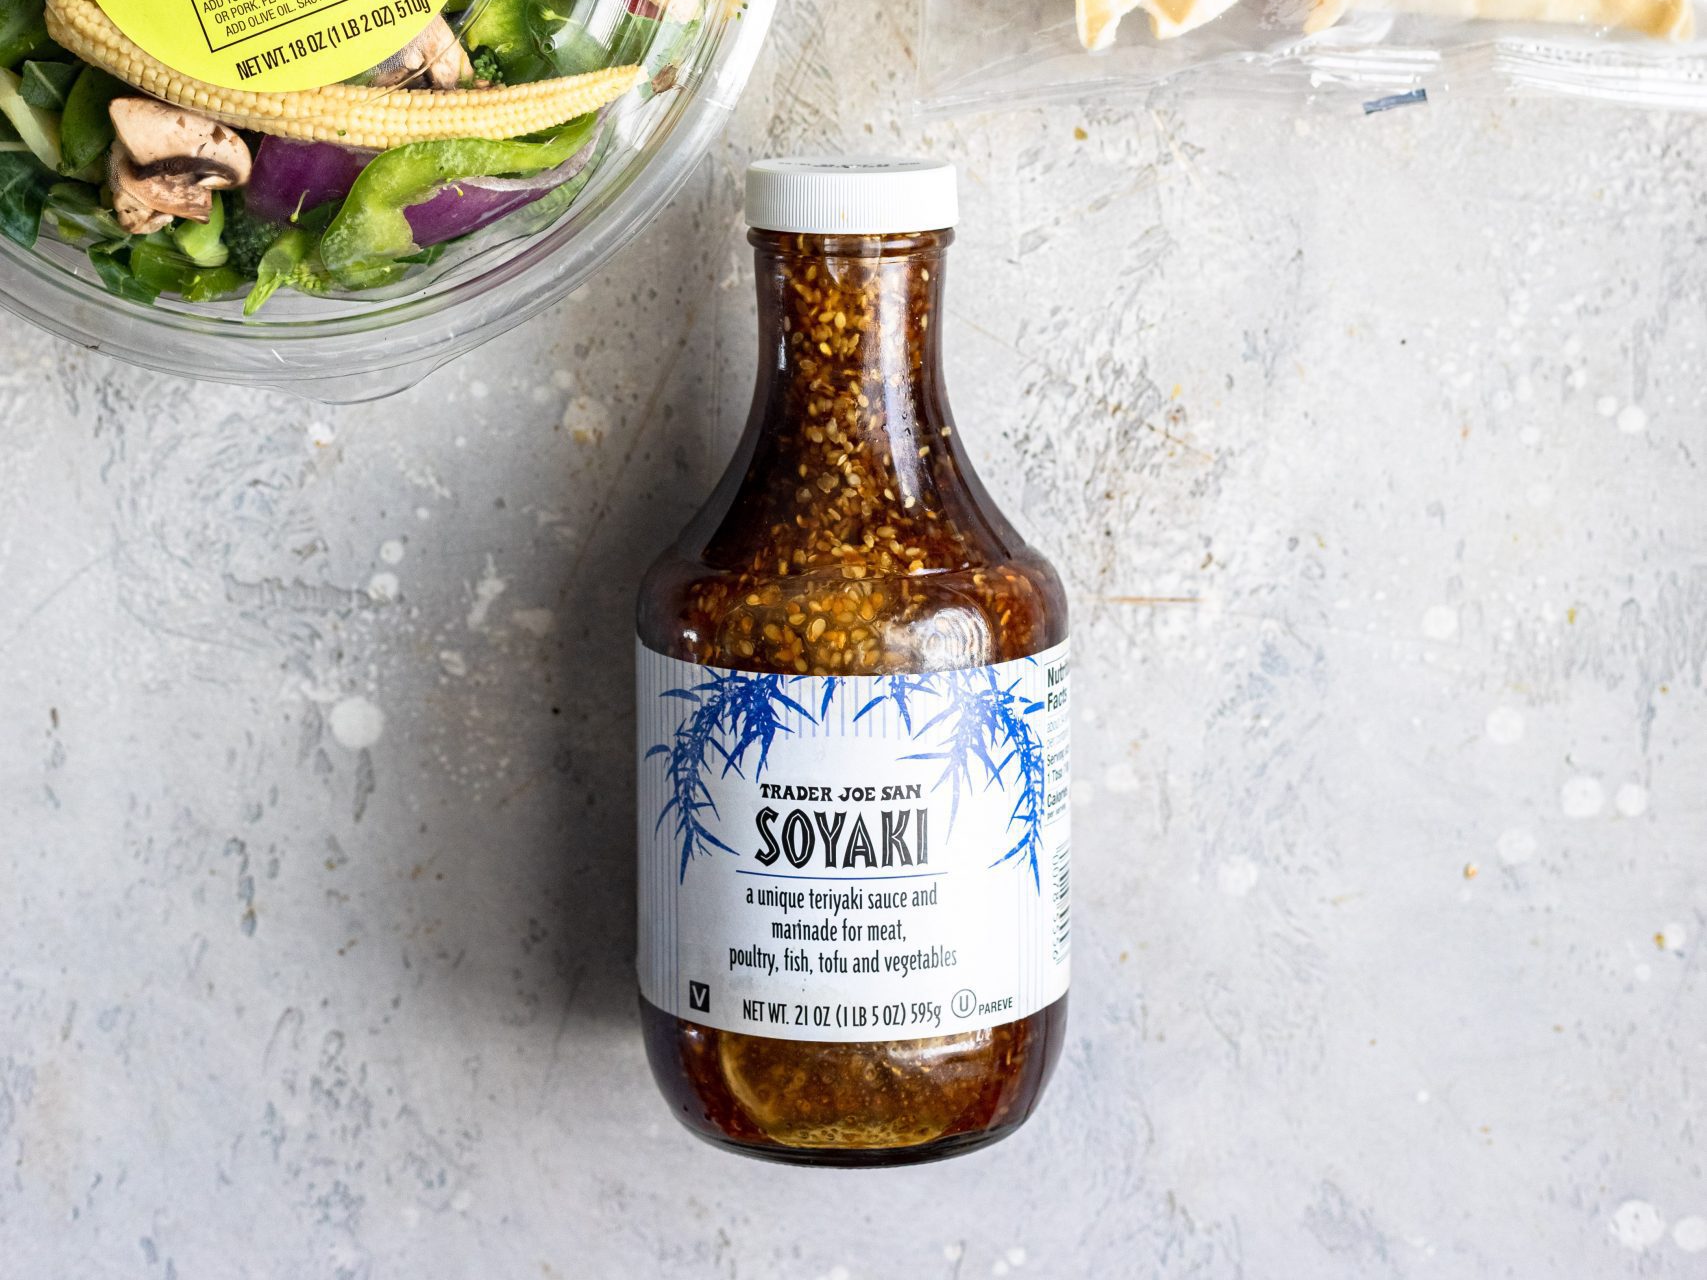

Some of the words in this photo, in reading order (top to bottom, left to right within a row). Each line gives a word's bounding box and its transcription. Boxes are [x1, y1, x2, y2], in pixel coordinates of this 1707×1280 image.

[215, 11, 229, 25] OR
[230, 0, 261, 18] PORK.
[226, 20, 247, 37] ADD
[248, 10, 277, 28] OLIVE
[276, 3, 297, 17] OIL.
[235, 52, 262, 81] NET
[261, 45, 291, 70] WT.
[288, 39, 307, 60] 18
[306, 31, 328, 53] OZ
[327, 24, 341, 49] (1
[340, 17, 361, 40] LB
[359, 14, 373, 32] 2
[372, 5, 396, 26] OZ)
[759, 783, 834, 802] TRADER
[837, 786, 878, 802] JOE
[880, 783, 923, 800] SAN
[754, 806, 929, 870] SOYAKI
[746, 887, 754, 905] a
[758, 886, 805, 915] unique
[809, 886, 863, 917] teriyaki
[868, 890, 907, 909] sauce
[912, 882, 938, 907] and
[772, 918, 838, 942] marinade
[842, 918, 863, 942] for
[867, 919, 906, 942] meat,
[729, 944, 779, 977] poultry,
[784, 947, 814, 975] fish,
[818, 950, 848, 974] tofu
[852, 950, 880, 973] and
[884, 945, 958, 979] vegetables
[691, 984, 708, 1009] V
[978, 996, 1013, 1016] PAREVE
[743, 998, 765, 1021] NET
[768, 1002, 790, 1025] WT.
[794, 1005, 808, 1027] 21
[813, 1006, 831, 1027] OZ
[836, 1004, 848, 1028] (1
[852, 1006, 867, 1027] LB
[872, 1006, 879, 1027] 5
[883, 1003, 906, 1027] OZ)
[911, 1001, 942, 1028] 595g
